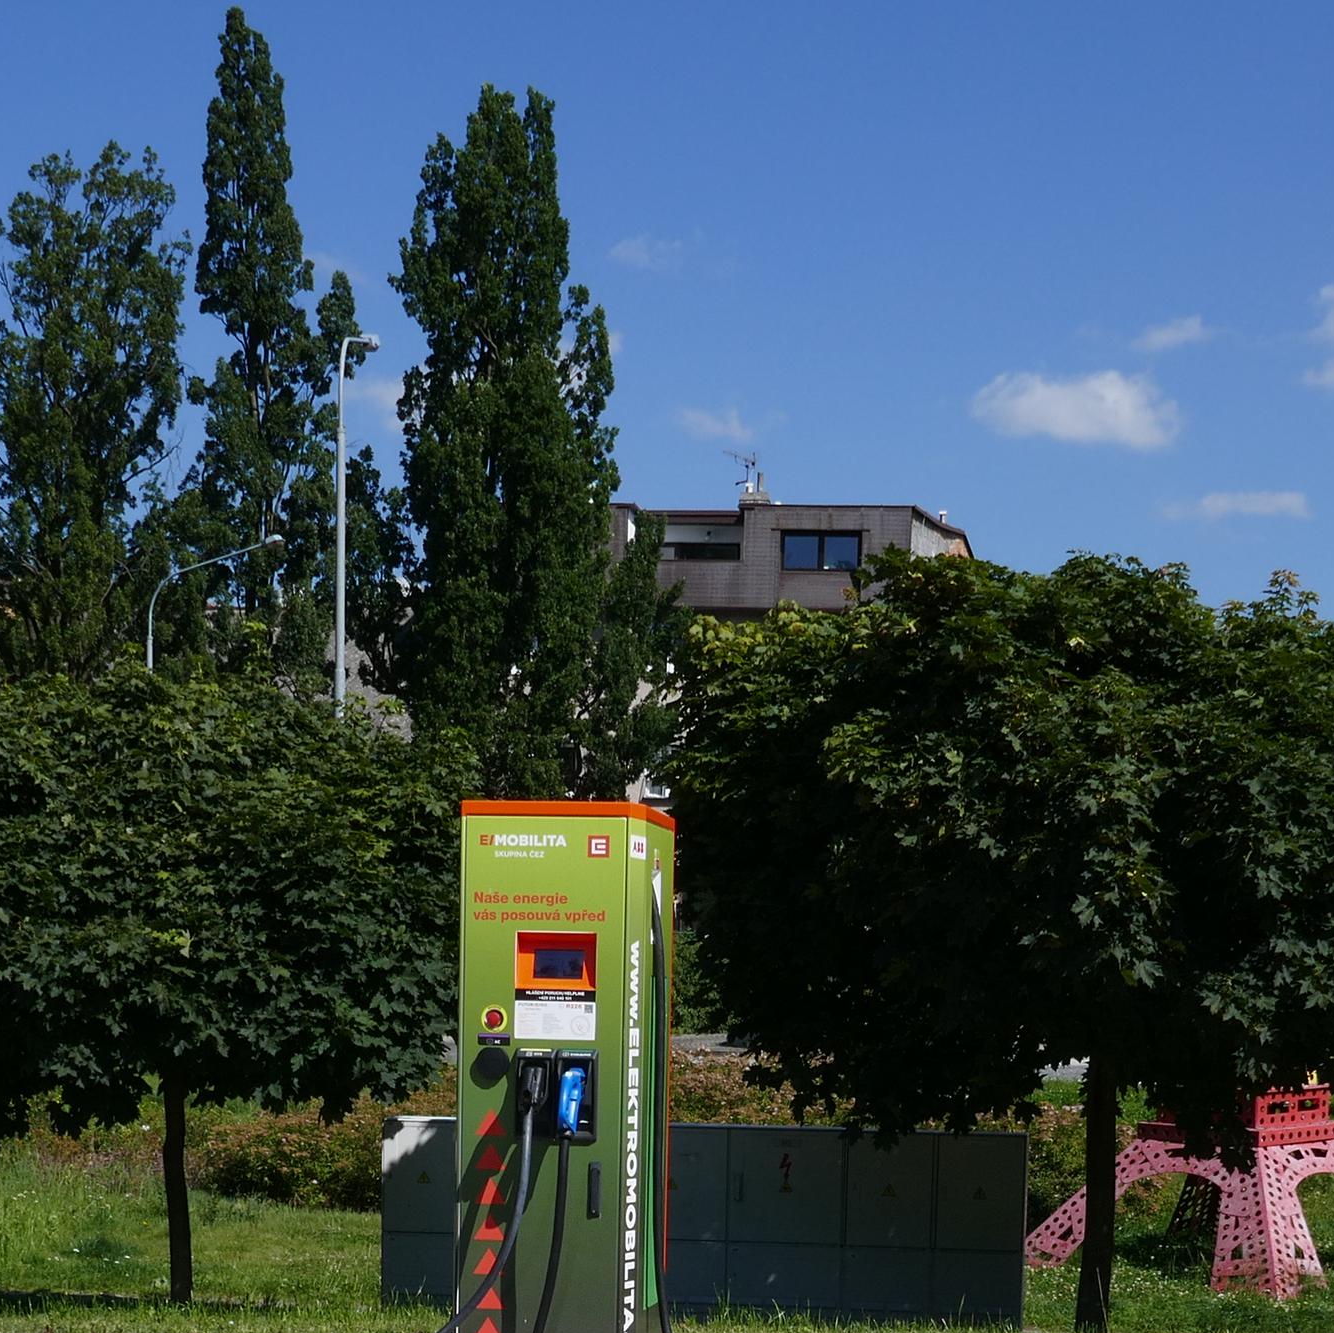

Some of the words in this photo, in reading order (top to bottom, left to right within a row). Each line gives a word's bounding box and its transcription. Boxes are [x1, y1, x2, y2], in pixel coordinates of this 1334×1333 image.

[479, 834, 567, 848] E/MOBILITA
[494, 850, 528, 858] SKUPINA
[529, 849, 545, 859] ČEZ
[474, 891, 509, 904] Naše
[513, 892, 569, 907] energie
[474, 909, 496, 921] vás
[501, 909, 560, 923] posouvá
[565, 909, 606, 923] vpřed
